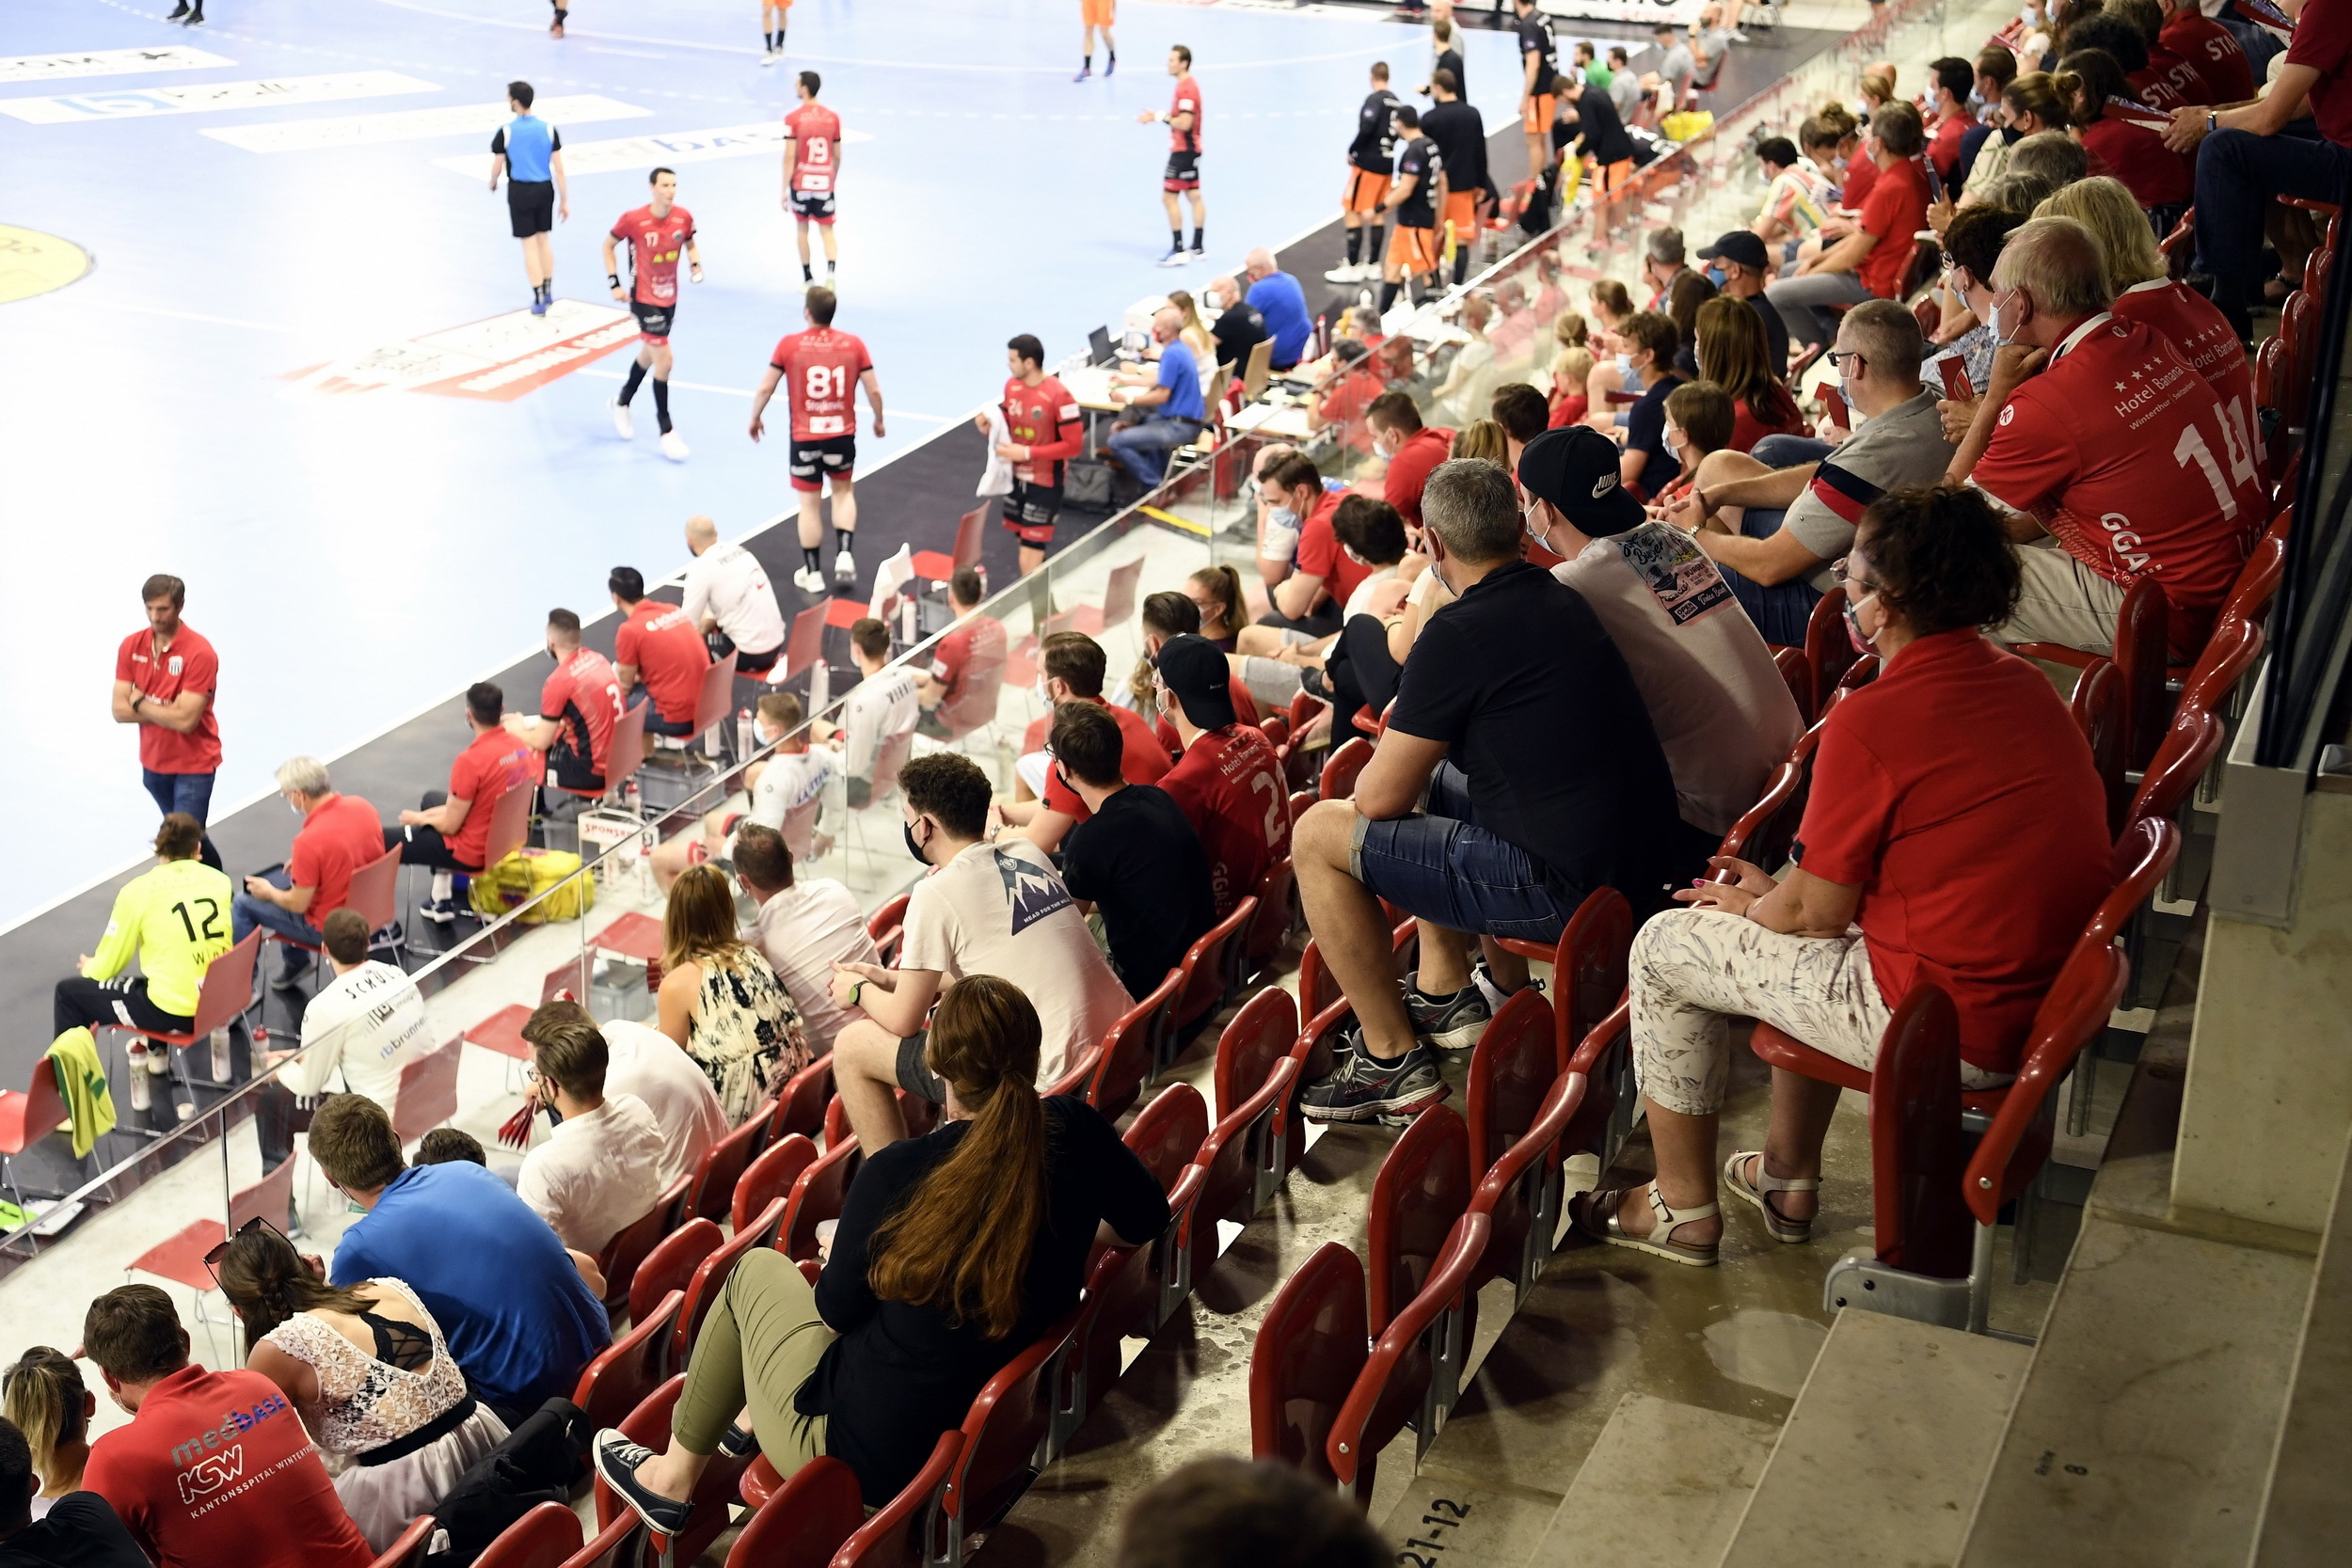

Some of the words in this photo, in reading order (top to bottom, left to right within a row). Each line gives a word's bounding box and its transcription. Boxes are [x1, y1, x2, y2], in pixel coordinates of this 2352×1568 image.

[806, 136, 829, 164] 19
[644, 231, 659, 247] 17
[2214, 337, 2238, 358] Banana
[806, 365, 846, 399] 81
[2114, 384, 2156, 418] Hotel
[2152, 366, 2185, 390] Banana
[1008, 398, 1024, 417] 24
[2129, 399, 2171, 431] Winterthur
[2173, 402, 2262, 521] 14
[1598, 471, 1616, 489] NIKE
[2101, 513, 2151, 572] GGA
[1220, 756, 1242, 776] Hotel
[171, 898, 224, 942] 12
[1024, 911, 1040, 923] HEAD
[1040, 904, 1051, 914] FOR
[1051, 901, 1061, 910] THE
[177, 1444, 243, 1505] KSW
[190, 1467, 276, 1519] KANTONSSPITAL
[1396, 1499, 1471, 1568] 21-12
